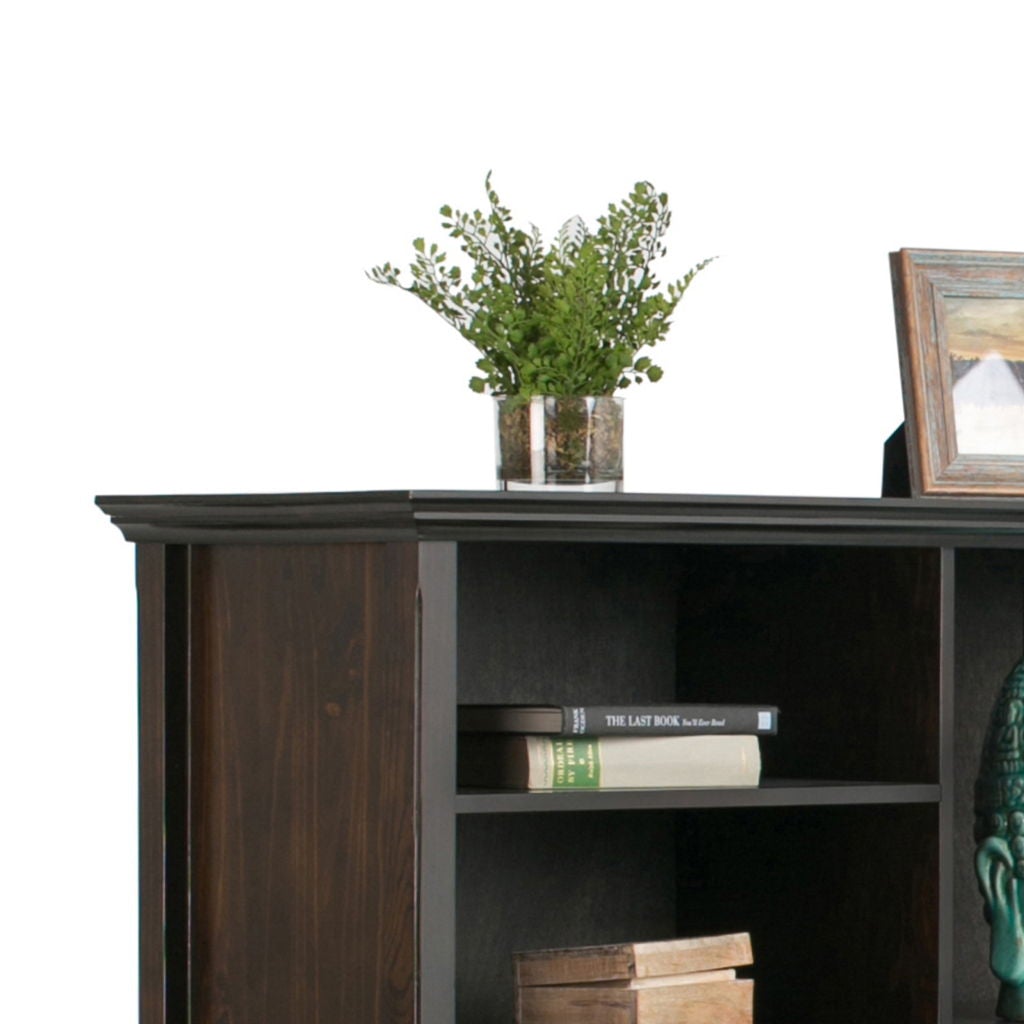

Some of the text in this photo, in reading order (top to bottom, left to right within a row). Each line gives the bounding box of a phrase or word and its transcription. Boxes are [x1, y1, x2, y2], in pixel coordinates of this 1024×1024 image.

[605, 715, 626, 727] THE
[628, 715, 652, 727] LAST
[654, 715, 681, 727] BOOK
[567, 769, 575, 784] BY
